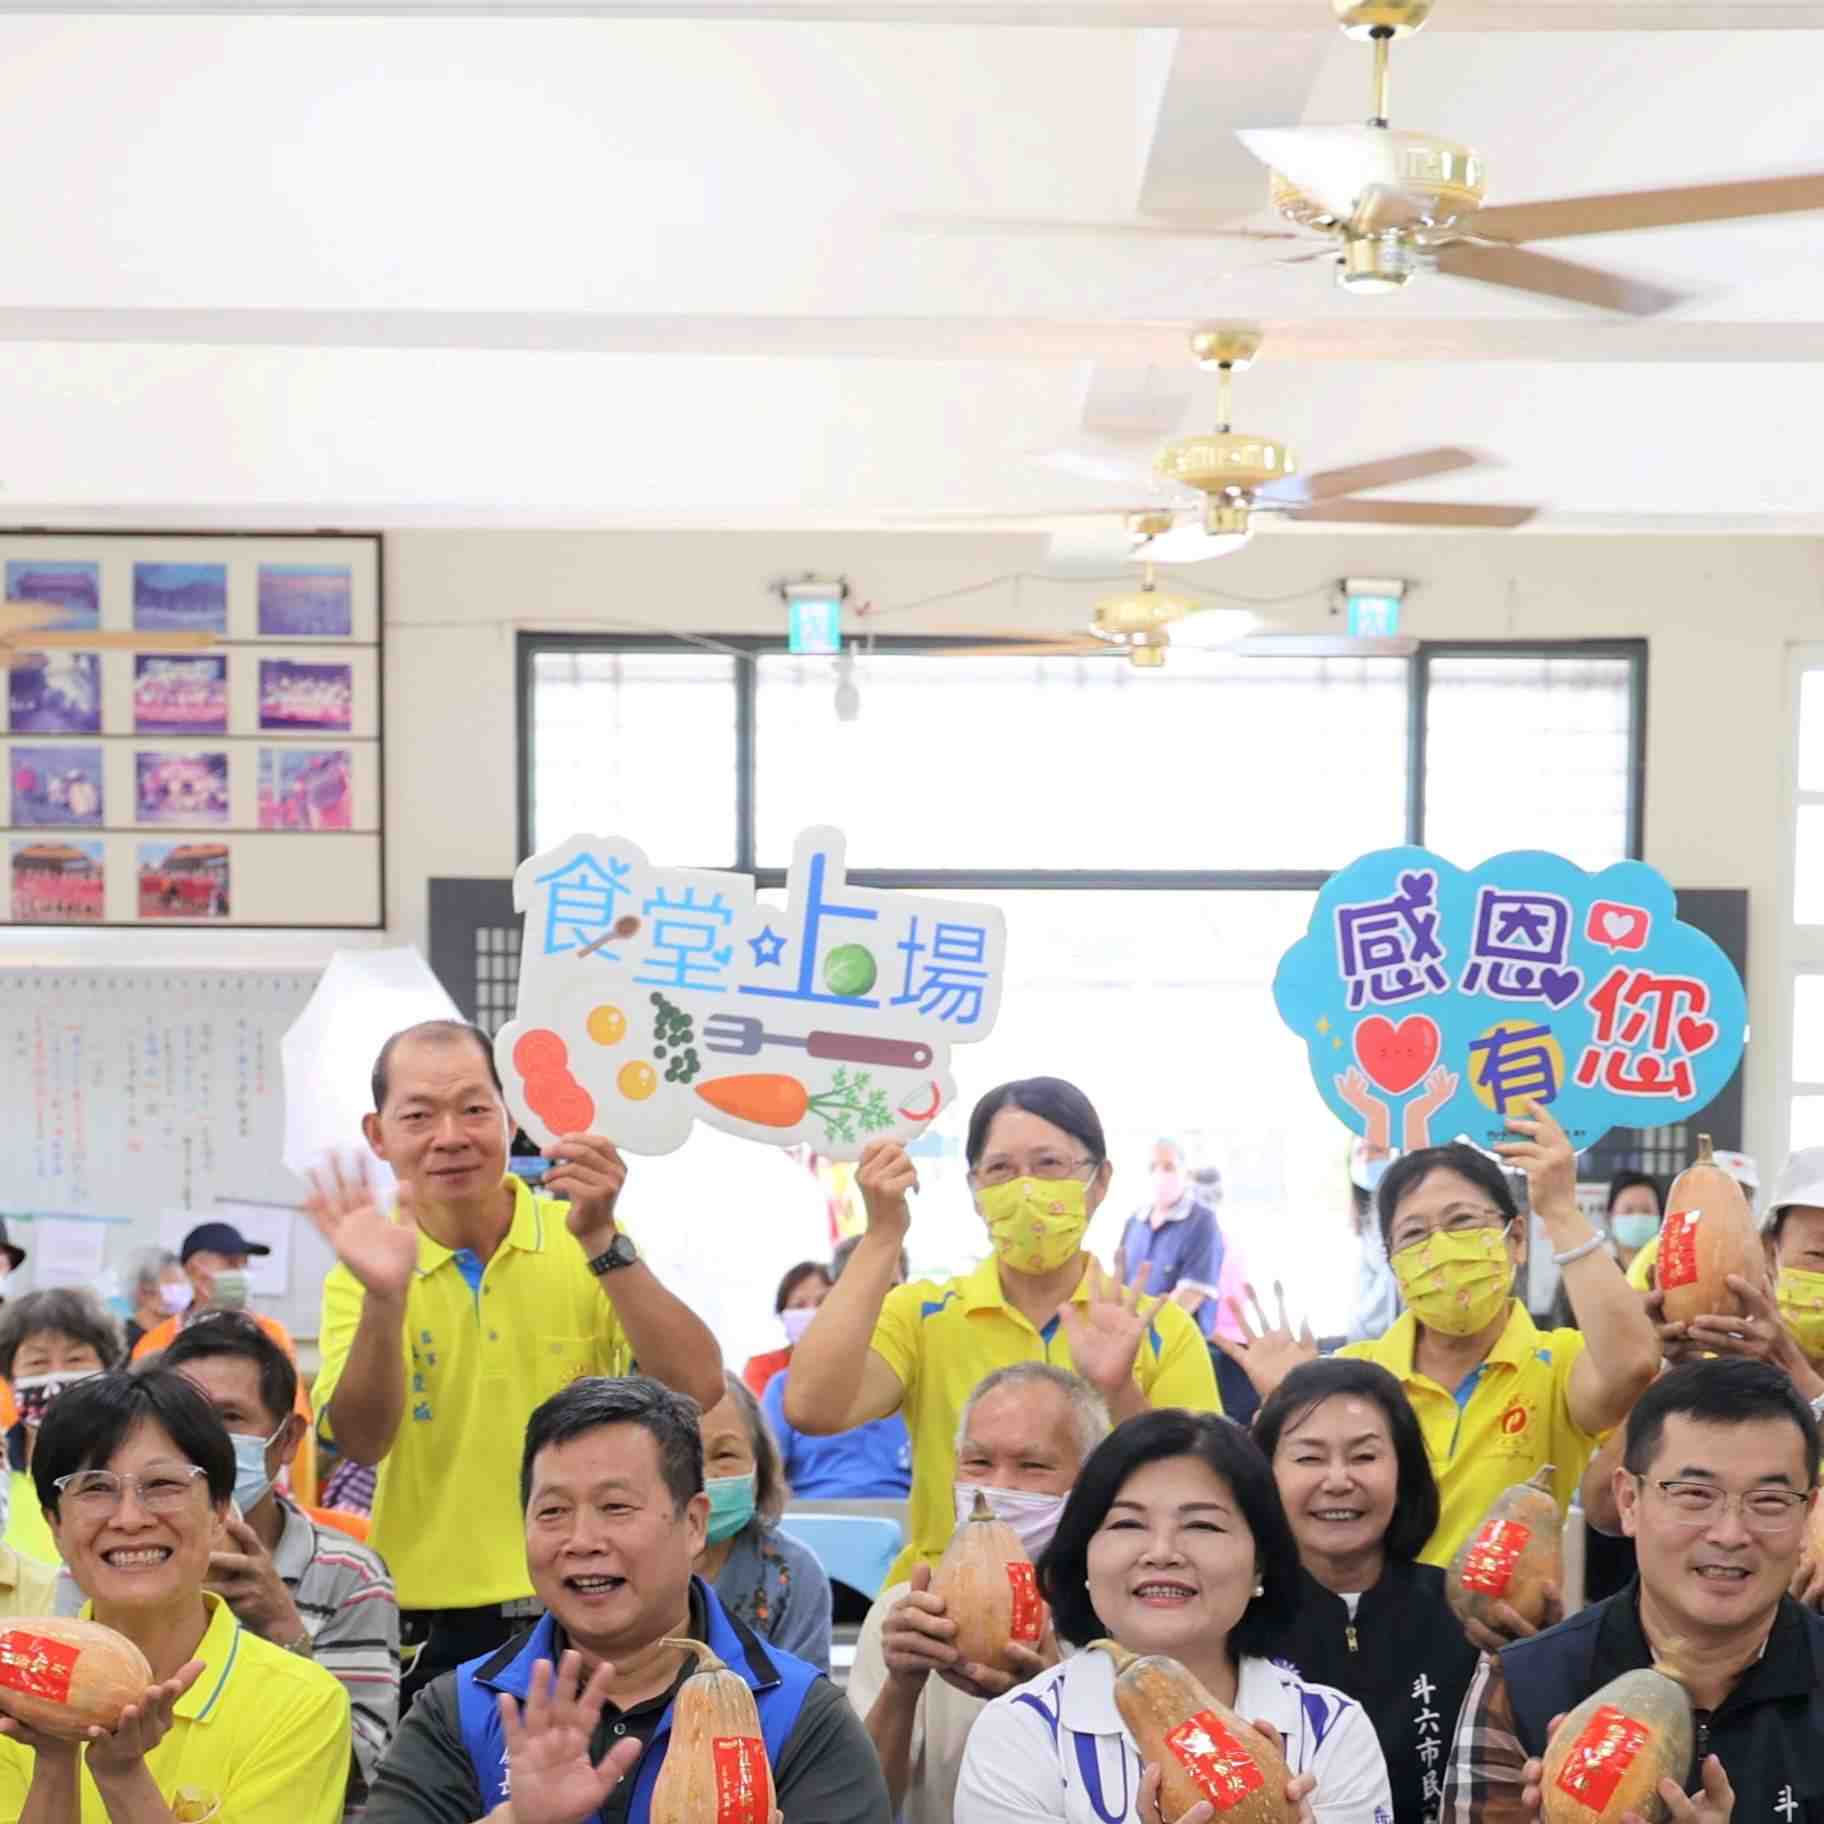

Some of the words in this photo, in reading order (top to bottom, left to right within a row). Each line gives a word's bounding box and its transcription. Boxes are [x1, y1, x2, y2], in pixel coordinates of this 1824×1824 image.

[534, 851, 733, 993] 食堂
[738, 853, 988, 1025] 上場
[1335, 870, 1582, 1010] 感恩
